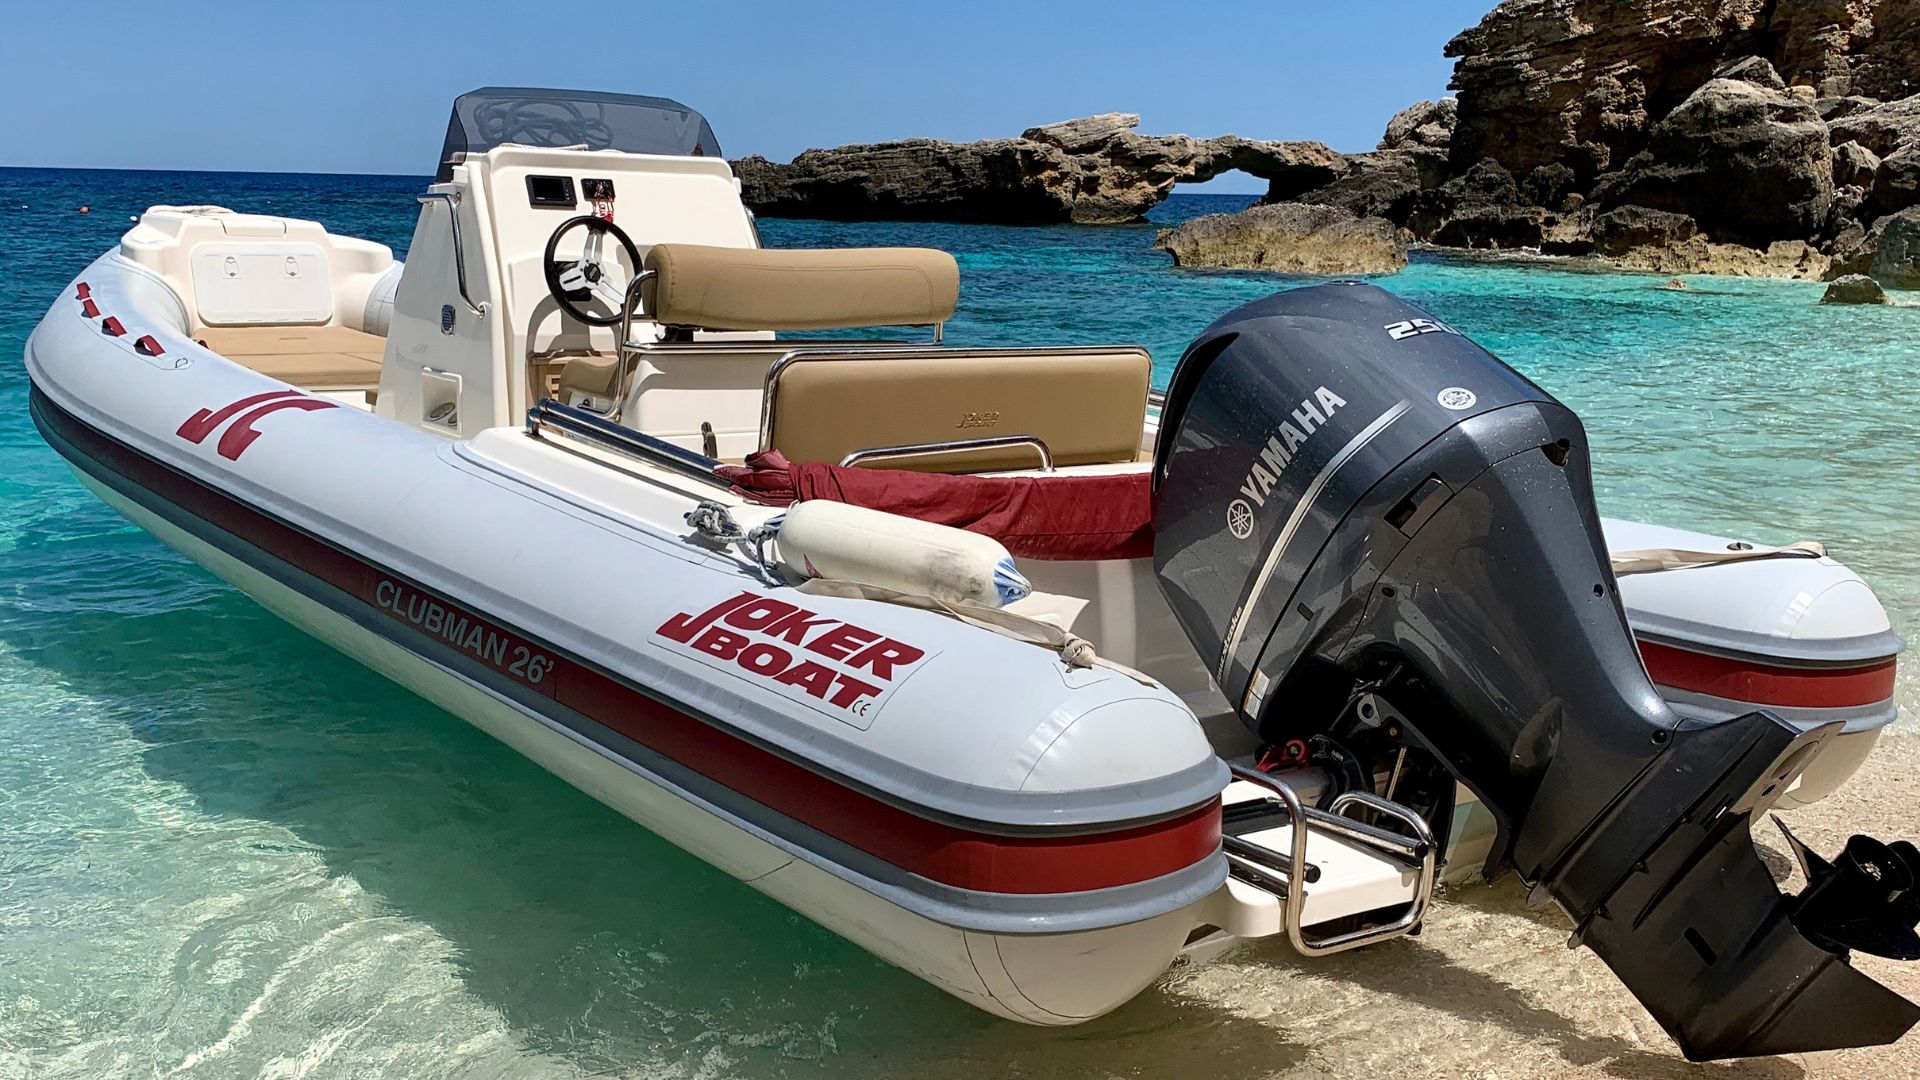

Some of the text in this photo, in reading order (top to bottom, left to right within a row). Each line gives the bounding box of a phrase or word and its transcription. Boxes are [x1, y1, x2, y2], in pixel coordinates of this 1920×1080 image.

[1240, 386, 1347, 507] YAMAHA
[376, 580, 508, 665] CLUBMAN
[655, 590, 925, 681] JOKER
[690, 625, 883, 709] BOAT
